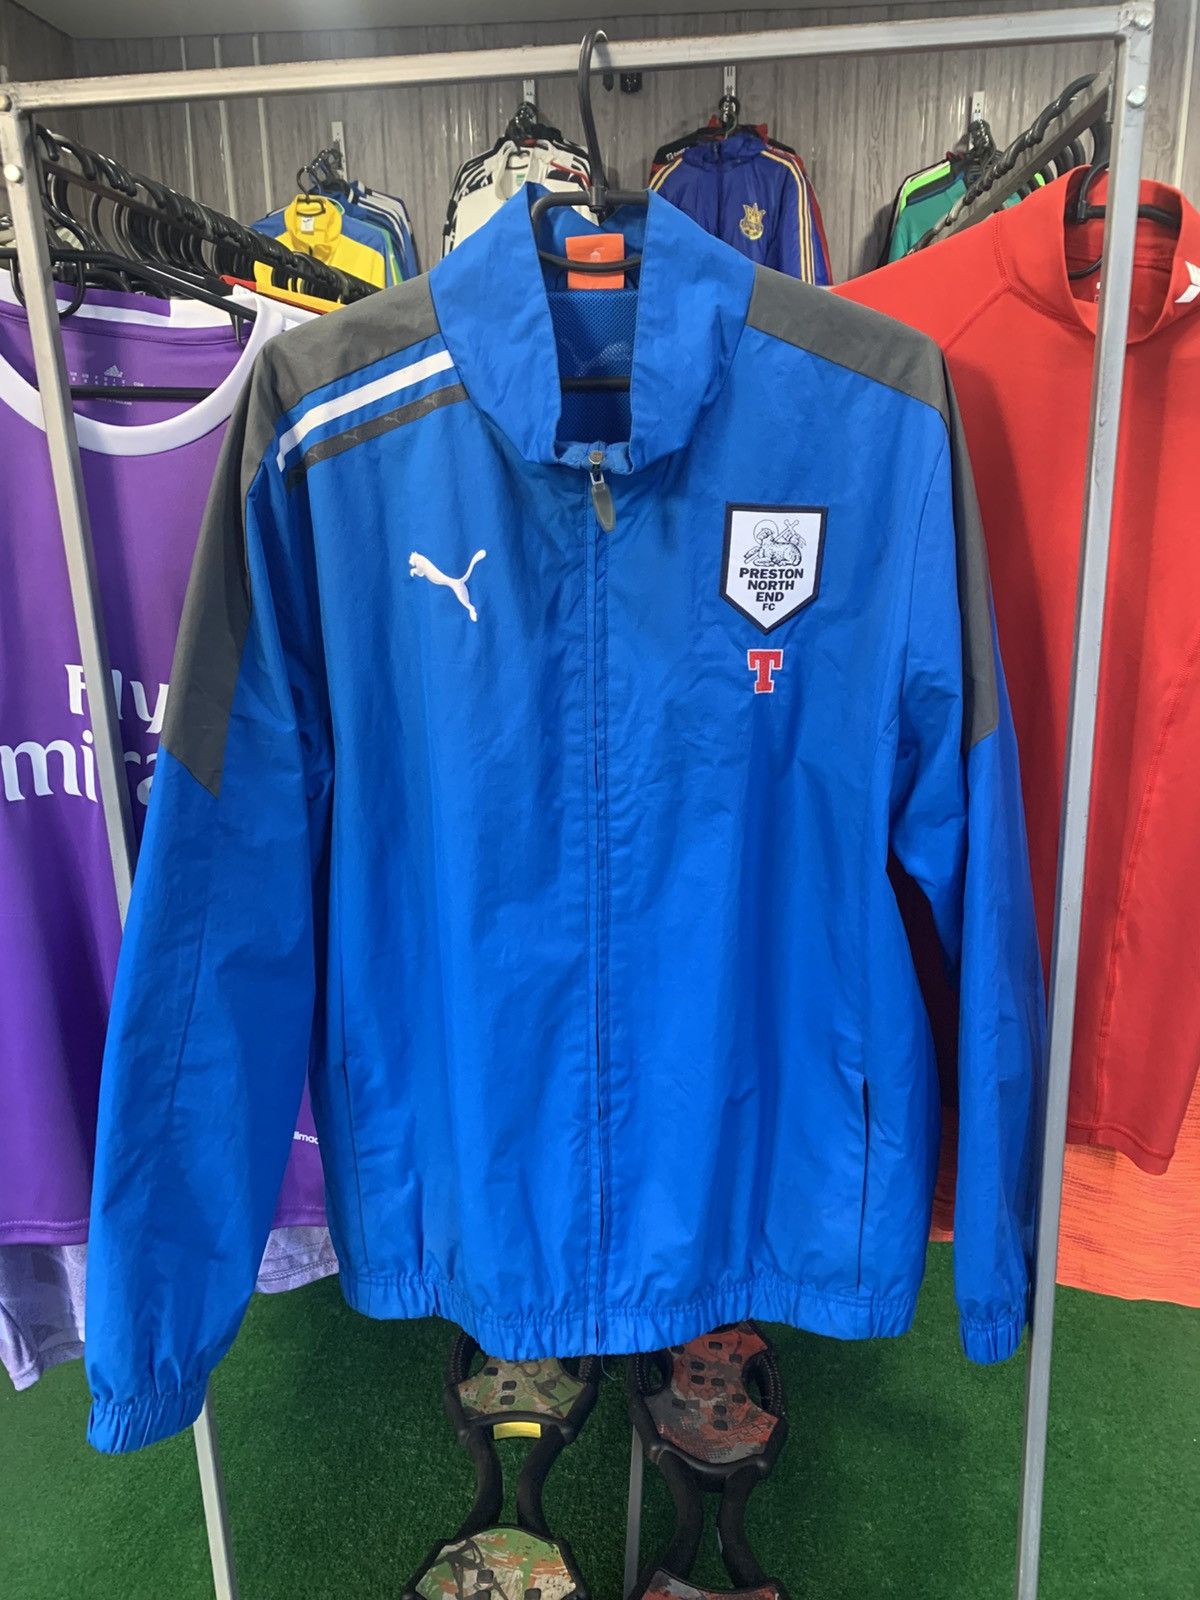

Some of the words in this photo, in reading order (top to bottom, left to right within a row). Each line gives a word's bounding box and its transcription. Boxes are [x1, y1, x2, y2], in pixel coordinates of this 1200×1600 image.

[739, 567, 804, 579] PRESTON
[747, 580, 795, 591] NORTH
[755, 591, 785, 602] END
[762, 603, 776, 611] FC
[747, 649, 784, 694] T
[64, 664, 169, 734] Fly
